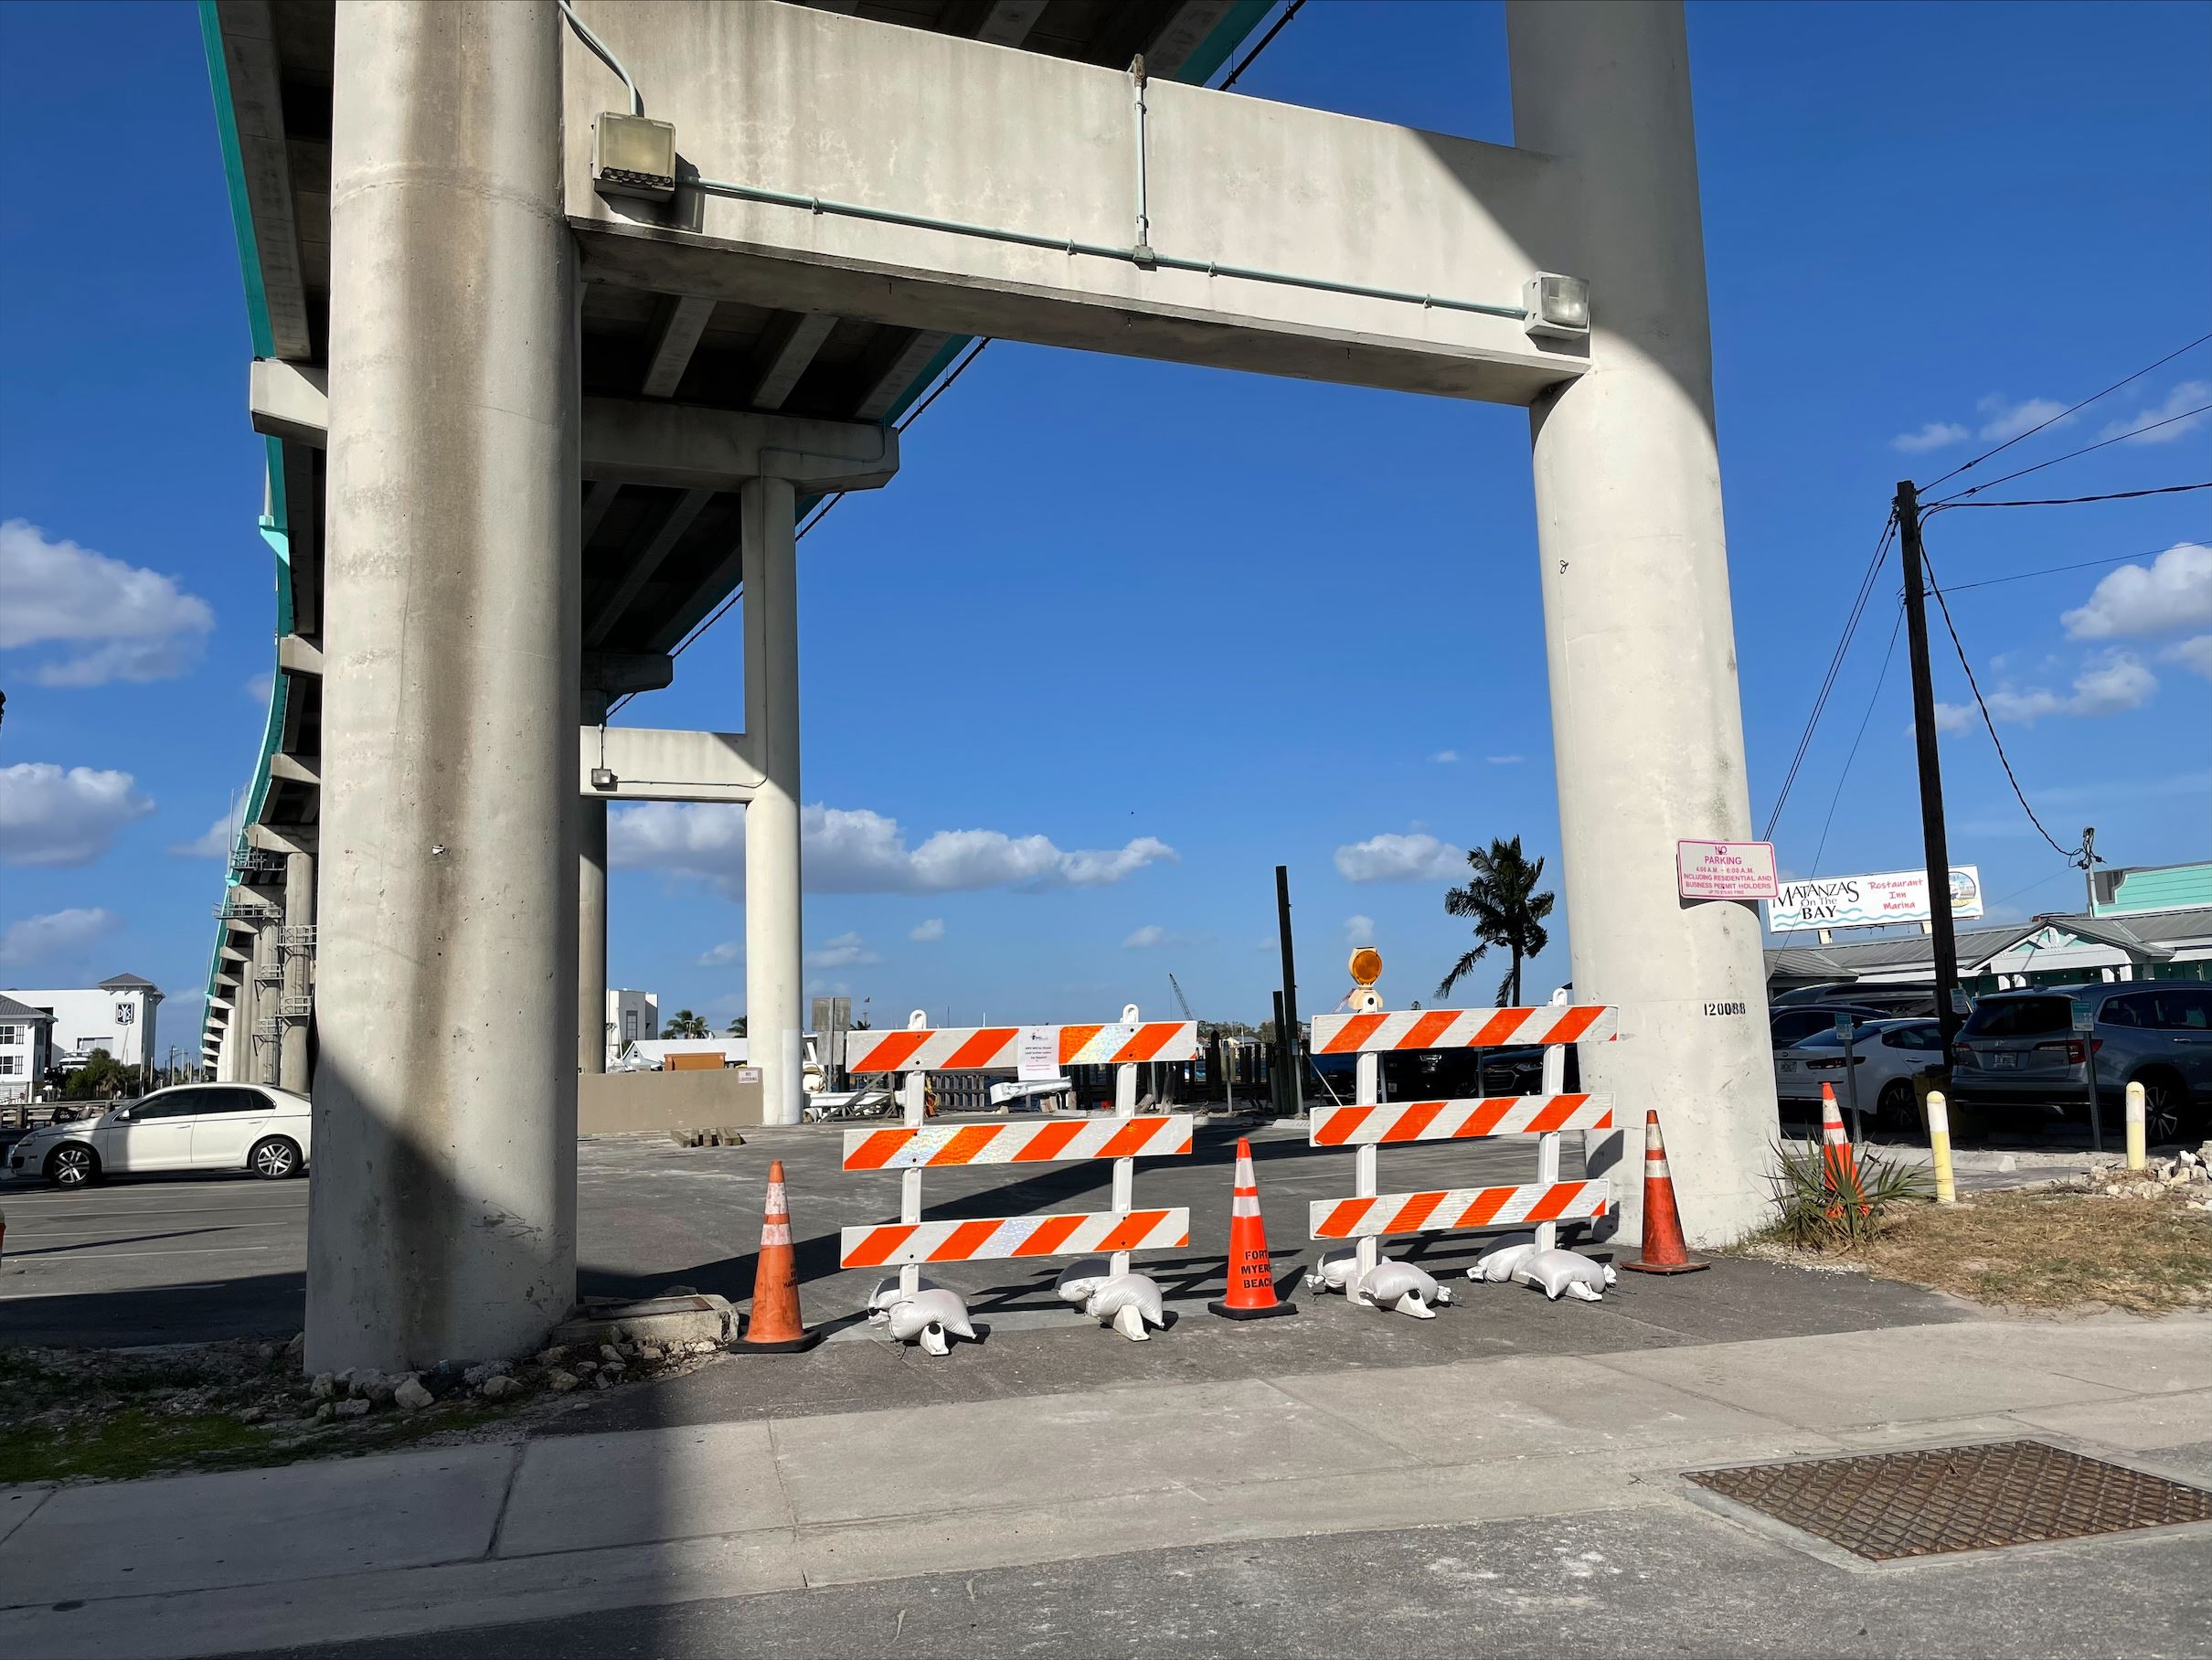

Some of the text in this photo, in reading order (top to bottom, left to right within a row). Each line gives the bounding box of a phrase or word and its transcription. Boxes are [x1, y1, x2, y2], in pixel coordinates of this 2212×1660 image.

[1715, 846, 1728, 855] NO
[1704, 856, 1742, 865] PARKING
[1867, 878, 1923, 889] Restaurant
[1773, 880, 1860, 908] MATANZAS
[1888, 891, 1907, 899] Inn
[1801, 896, 1837, 907] On The
[1883, 901, 1916, 910] Marina
[1802, 905, 1836, 920] BAY
[1704, 1002, 1746, 1016] 120088
